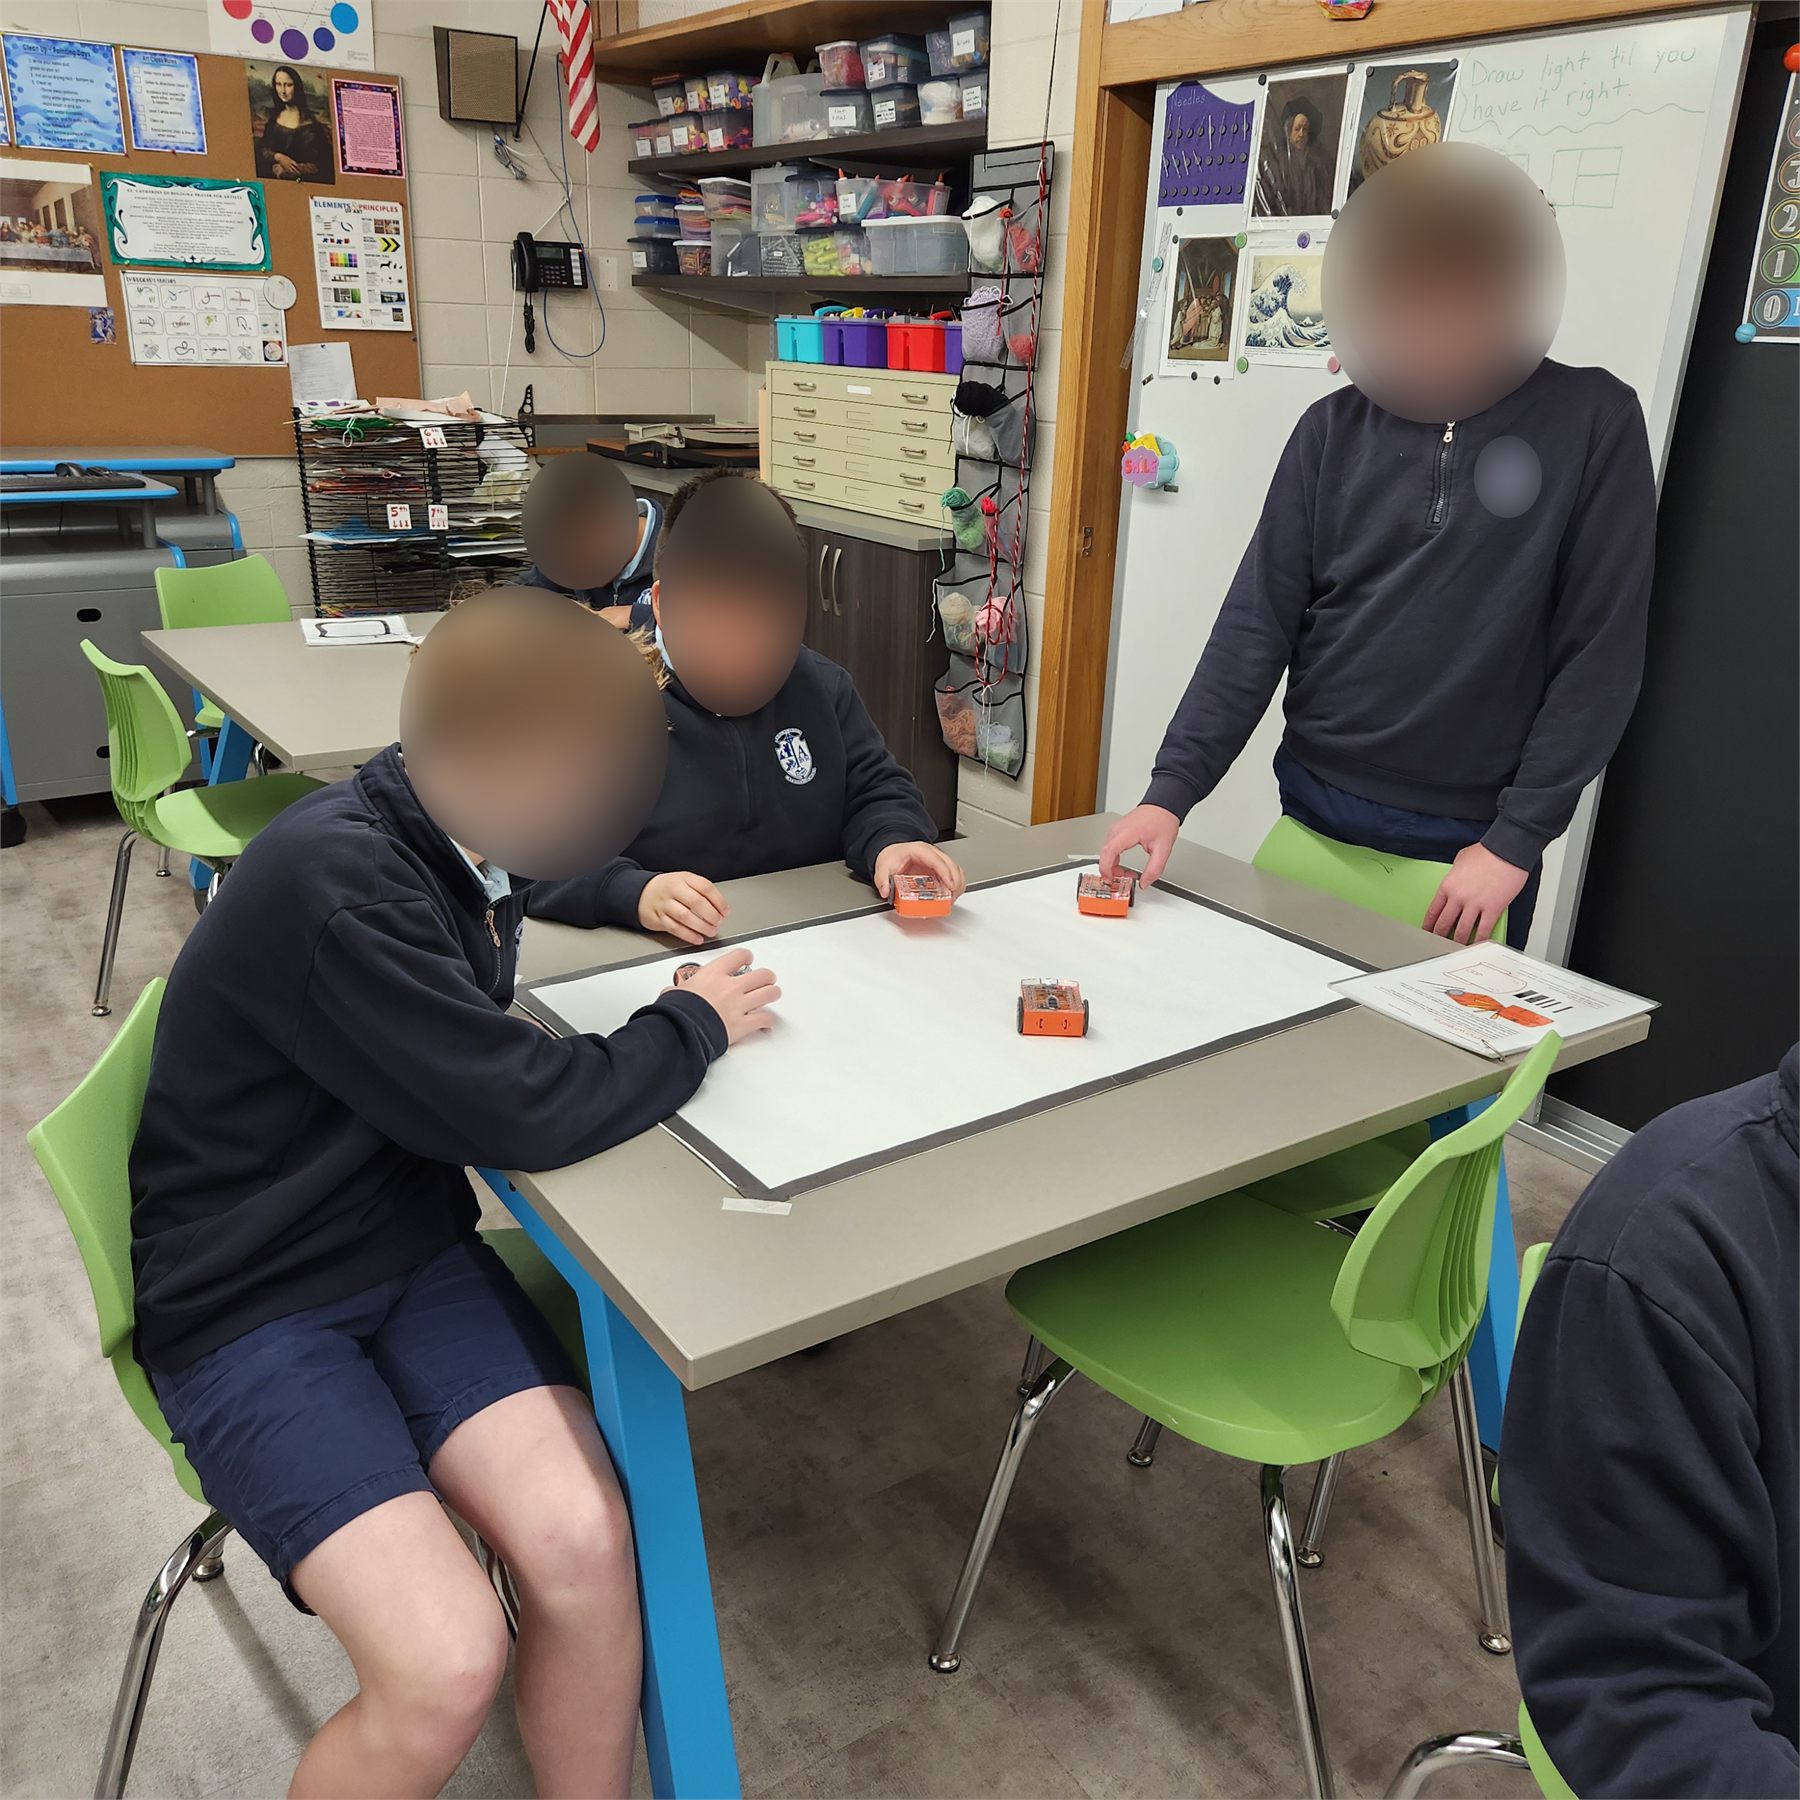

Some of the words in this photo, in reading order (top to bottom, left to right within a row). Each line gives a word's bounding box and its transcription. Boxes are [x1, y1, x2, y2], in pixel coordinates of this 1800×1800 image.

[1471, 59, 1525, 87] Draw
[1540, 49, 1591, 92] light
[1654, 48, 1697, 74] you
[1170, 89, 1206, 110] Needles
[1472, 94, 1523, 121] have
[1533, 88, 1549, 111] it
[1566, 78, 1632, 117] right.
[314, 200, 351, 209] ELEMENTS
[358, 203, 399, 213] PRINCIPLES
[1779, 203, 1798, 233] 2
[1773, 250, 1786, 278] 1
[1763, 294, 1781, 323] 0
[423, 428, 439, 437] 6th
[390, 506, 408, 518] 5th
[431, 508, 445, 518] 7th
